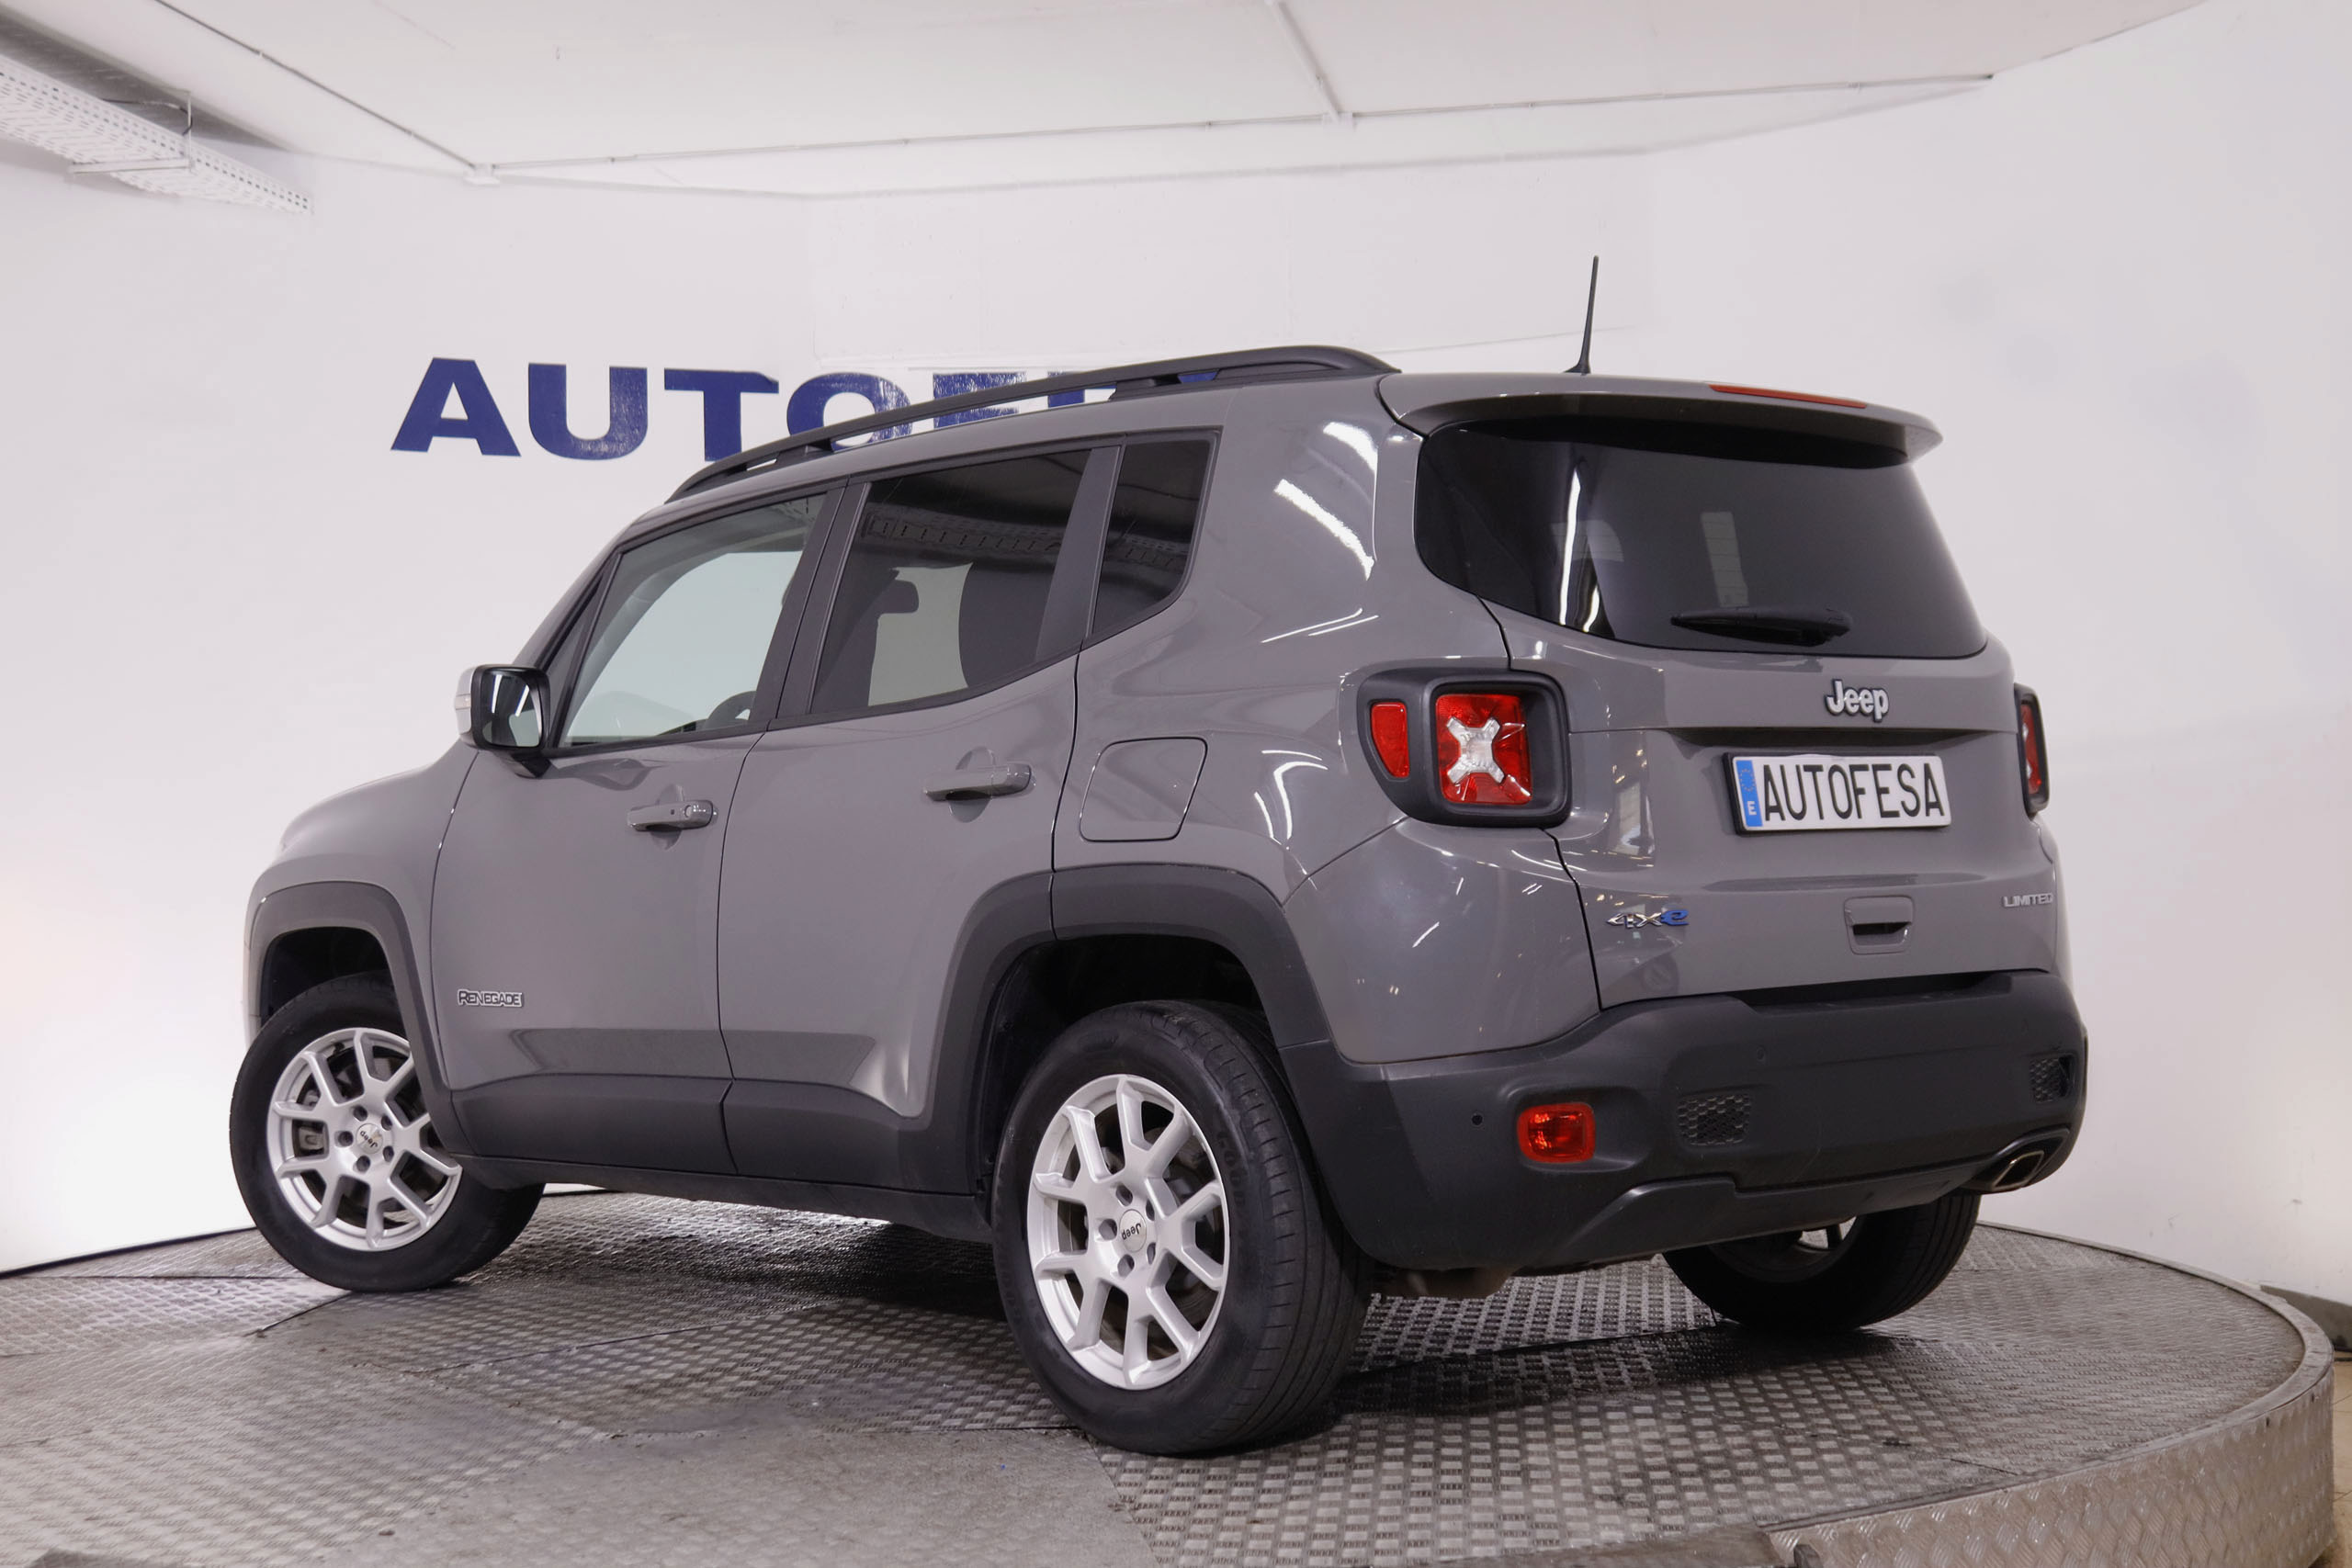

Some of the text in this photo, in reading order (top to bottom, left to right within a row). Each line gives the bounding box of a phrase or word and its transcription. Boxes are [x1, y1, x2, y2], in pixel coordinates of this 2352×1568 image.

[1826, 679, 1889, 722] Jeep
[1762, 762, 1946, 822] AUTOFESA
[1747, 801, 1758, 816] E
[2003, 893, 2054, 908] LIMITED
[458, 988, 523, 1008] RENEGADE
[359, 1130, 379, 1148] Jeep
[1122, 1223, 1142, 1240] Jeep
